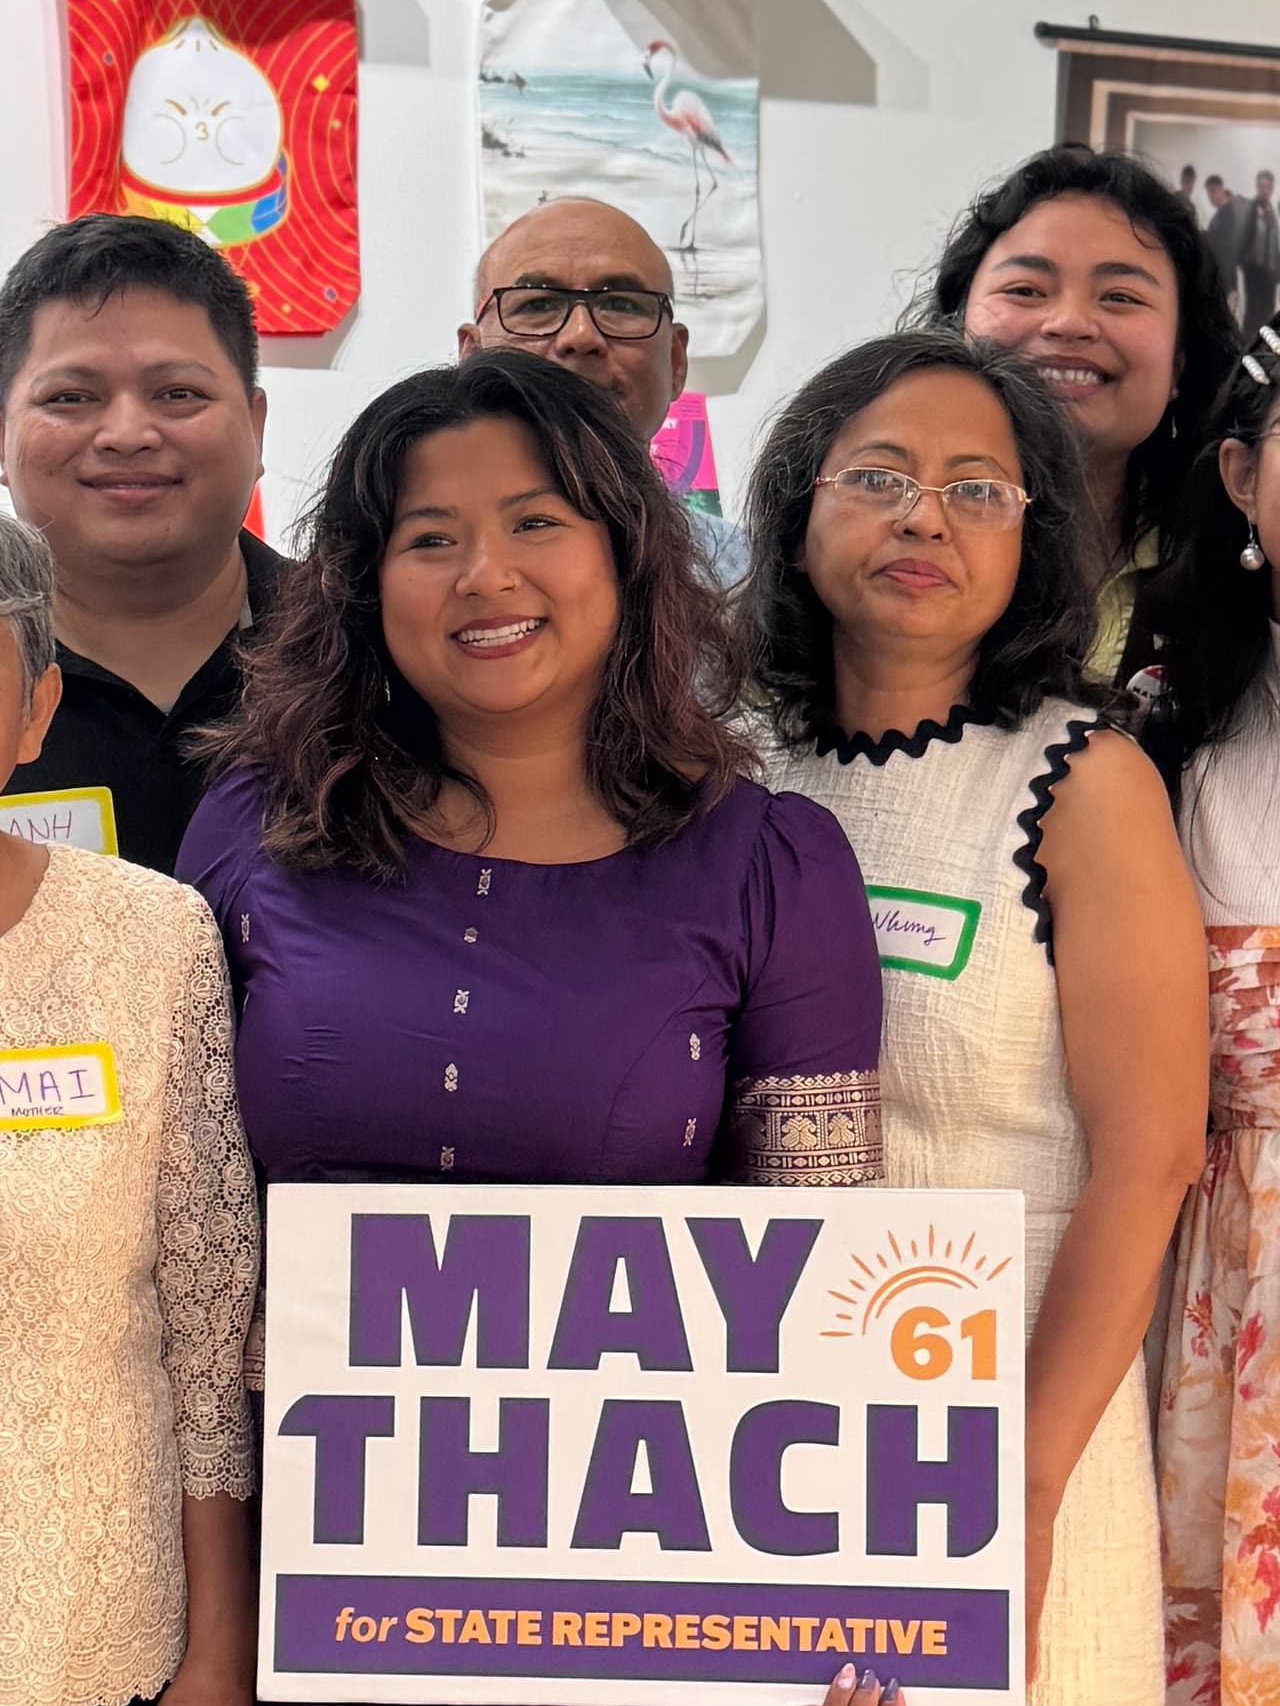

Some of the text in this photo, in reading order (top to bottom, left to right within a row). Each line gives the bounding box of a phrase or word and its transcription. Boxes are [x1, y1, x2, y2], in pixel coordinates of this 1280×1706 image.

[349, 1212, 825, 1374] MAY
[890, 1305, 998, 1381] 61
[278, 1394, 999, 1558] THACH
[335, 1607, 948, 1657] for STATE REPRESENTATIVE
